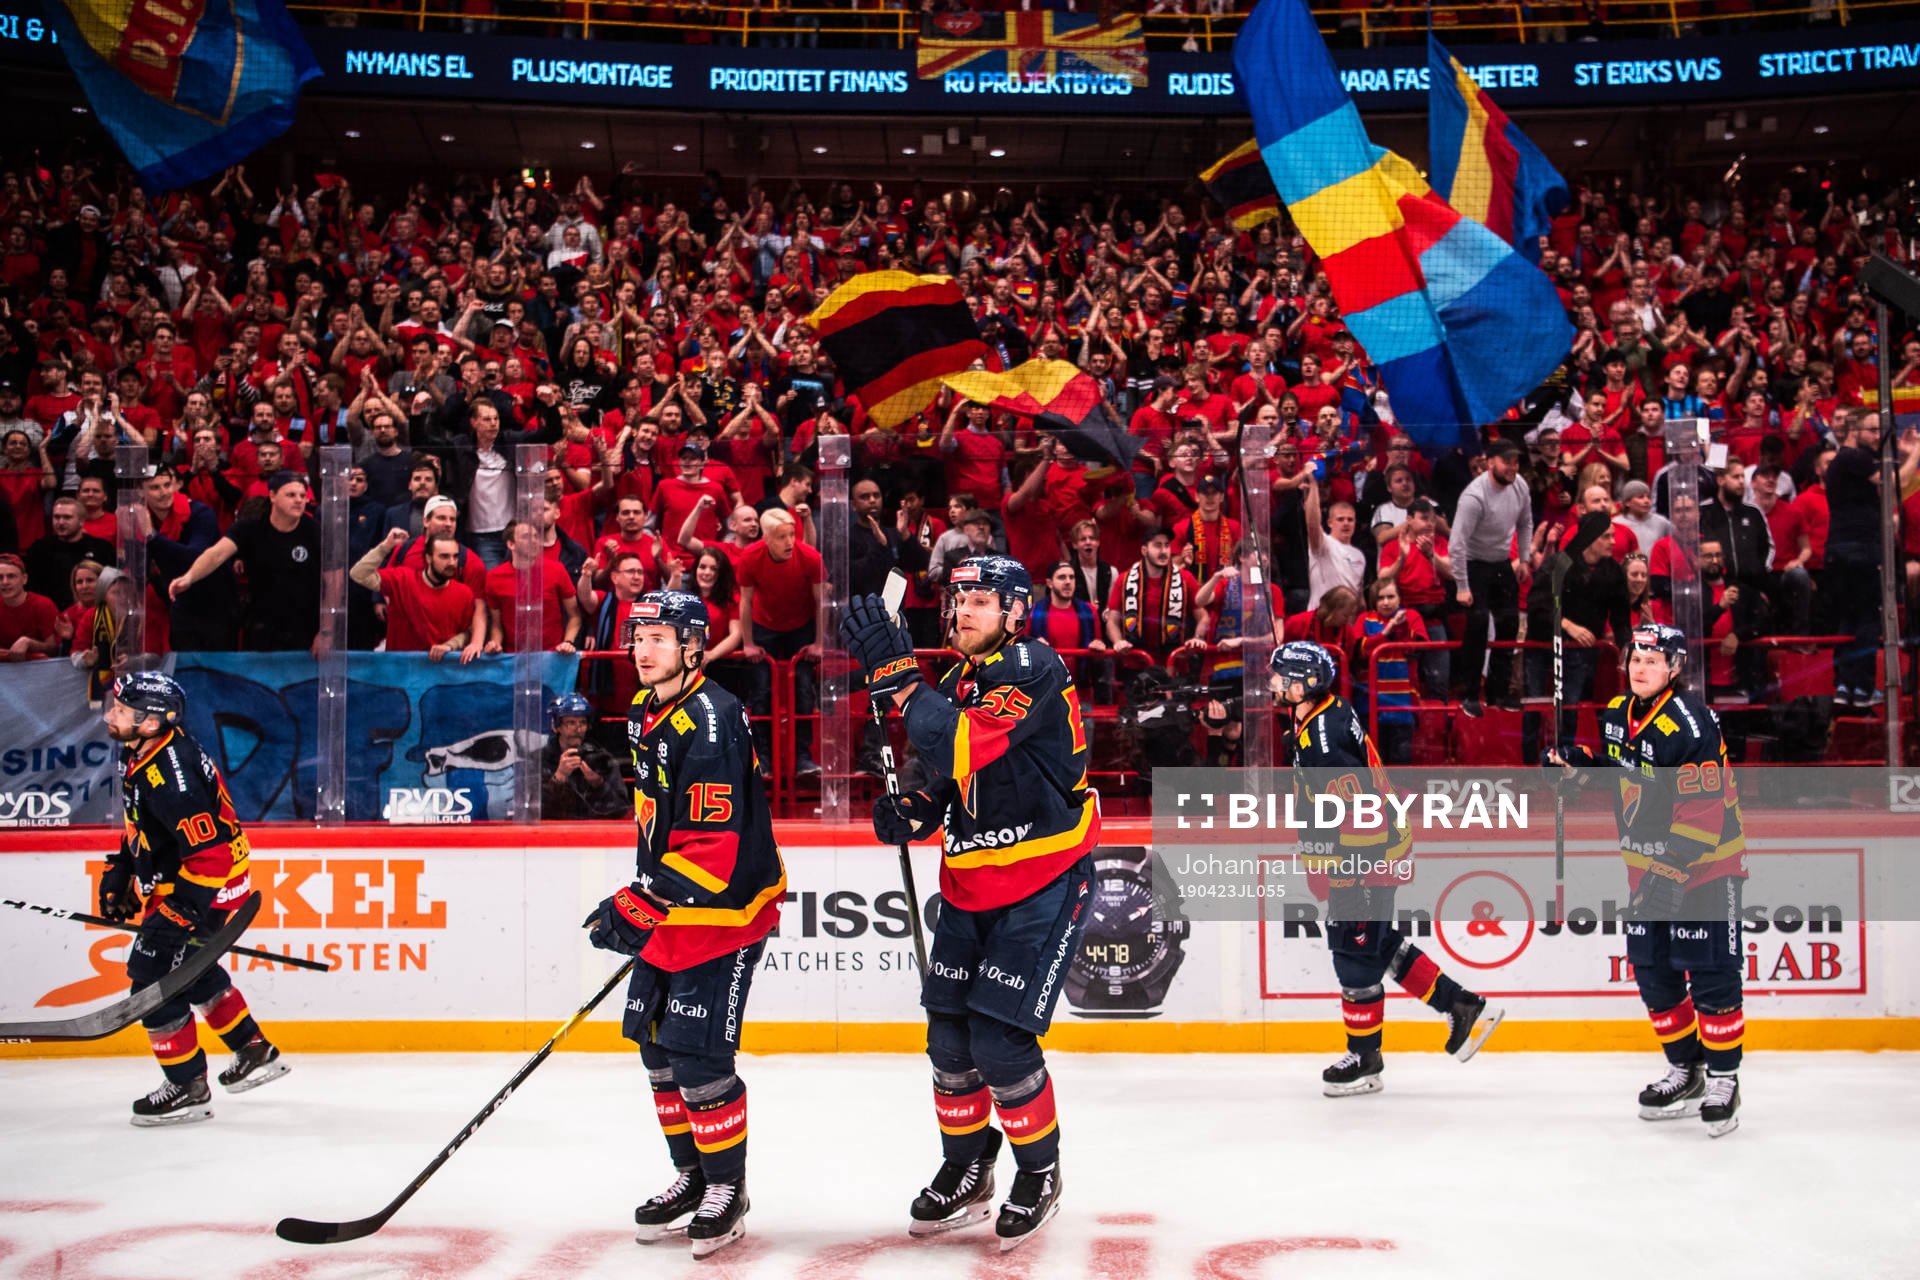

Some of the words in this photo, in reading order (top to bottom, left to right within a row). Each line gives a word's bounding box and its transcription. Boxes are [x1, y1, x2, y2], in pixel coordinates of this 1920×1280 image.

[26, 18, 44, 41] &
[346, 50, 442, 78] NYMANS
[445, 53, 474, 79] EL
[512, 57, 673, 89] PLUSMONTAGE
[1574, 62, 1601, 86] ST
[1606, 60, 1673, 85] ERIKS
[1675, 57, 1722, 82] VVS
[1759, 48, 1857, 78] STRICCT
[710, 67, 825, 93] PRIORITET
[828, 69, 909, 93] FINANS
[1168, 72, 1235, 96] RUDIS
[1340, 68, 1391, 92] ARA
[2, 740, 109, 777] SINC
[1676, 760, 1722, 795] 28
[389, 787, 473, 816] RYDS
[685, 782, 732, 823] 15
[176, 811, 218, 847] 10
[1103, 878, 1125, 892] 12
[616, 892, 660, 929] CCM
[1466, 900, 1508, 937] &
[1676, 927, 1709, 941] Ocab
[763, 951, 864, 972] ATCHES
[878, 951, 920, 972] SIN
[1085, 943, 1130, 964] 4478
[1767, 941, 1843, 982] AB
[934, 963, 970, 982] Ocab
[987, 964, 1026, 991] Ocab
[1033, 920, 1076, 1020] RIDDERMARK
[724, 945, 749, 1043] RIDDERMARK
[670, 1000, 708, 1019] Ocab
[690, 1109, 746, 1135] Stavdal
